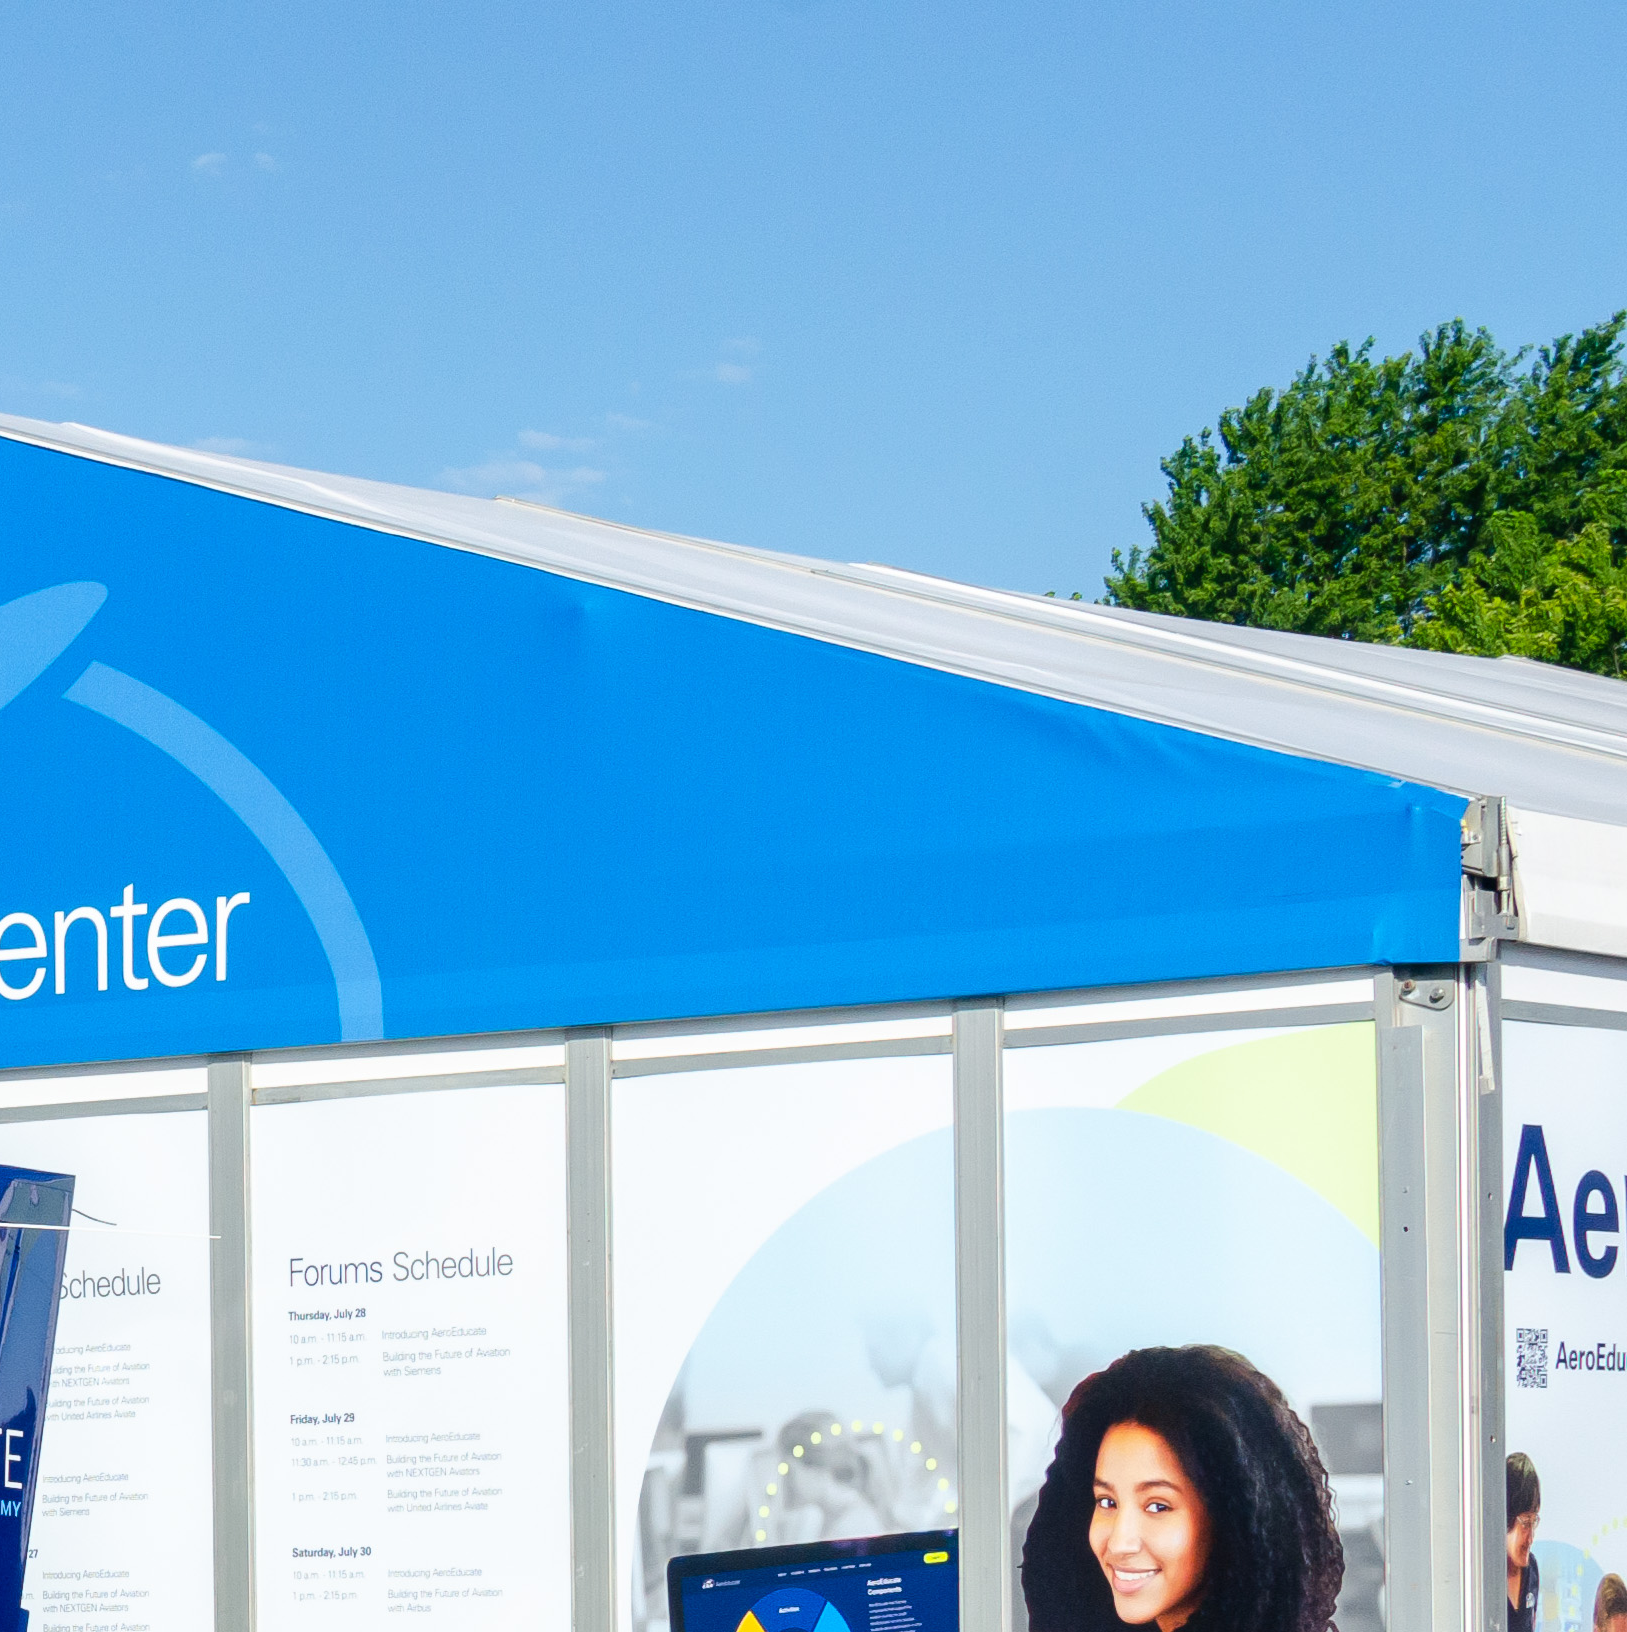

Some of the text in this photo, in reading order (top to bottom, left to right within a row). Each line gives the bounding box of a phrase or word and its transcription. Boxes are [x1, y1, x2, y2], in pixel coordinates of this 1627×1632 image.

[1504, 1124, 1627, 1279] Ae
[290, 1247, 513, 1287] Forums Schedule
[289, 1308, 366, 1321] Thursday, July 28
[382, 1327, 486, 1341] Introducing AeroEducate
[86, 1343, 130, 1353] AeroEducate
[383, 1347, 510, 1363] Building the Future of Aviation
[88, 1364, 110, 1373] Future
[122, 1362, 150, 1371] Aviation
[384, 1366, 441, 1376] with Siemens
[62, 1378, 99, 1387] NEXTGEN
[74, 1398, 85, 1407] the
[87, 1397, 109, 1406] Future
[121, 1396, 149, 1404] Aviation
[62, 1412, 84, 1421] United
[291, 1413, 355, 1425] Friday, July 29
[386, 1432, 480, 1445] Introducing AeroEducate
[387, 1451, 501, 1465] Building the Future of Aviation
[43, 1473, 128, 1484] Introducing AeroEducate
[387, 1469, 403, 1478] with
[406, 1468, 446, 1477] NEXTGEN
[42, 1494, 69, 1504] Building
[388, 1487, 502, 1500] Building the Future of Aviation
[388, 1504, 404, 1513] with
[406, 1503, 431, 1512] United
[29, 1549, 38, 1559] 27
[292, 1546, 371, 1559] Saturday, July 30
[43, 1569, 129, 1581] Introducing AeroEducate
[388, 1567, 482, 1579] Introducing AeroEducate
[43, 1590, 70, 1600] Building
[388, 1589, 417, 1599] Building
[420, 1589, 432, 1598] the
[435, 1588, 459, 1598] Future
[60, 1603, 97, 1613] NEXTGEN
